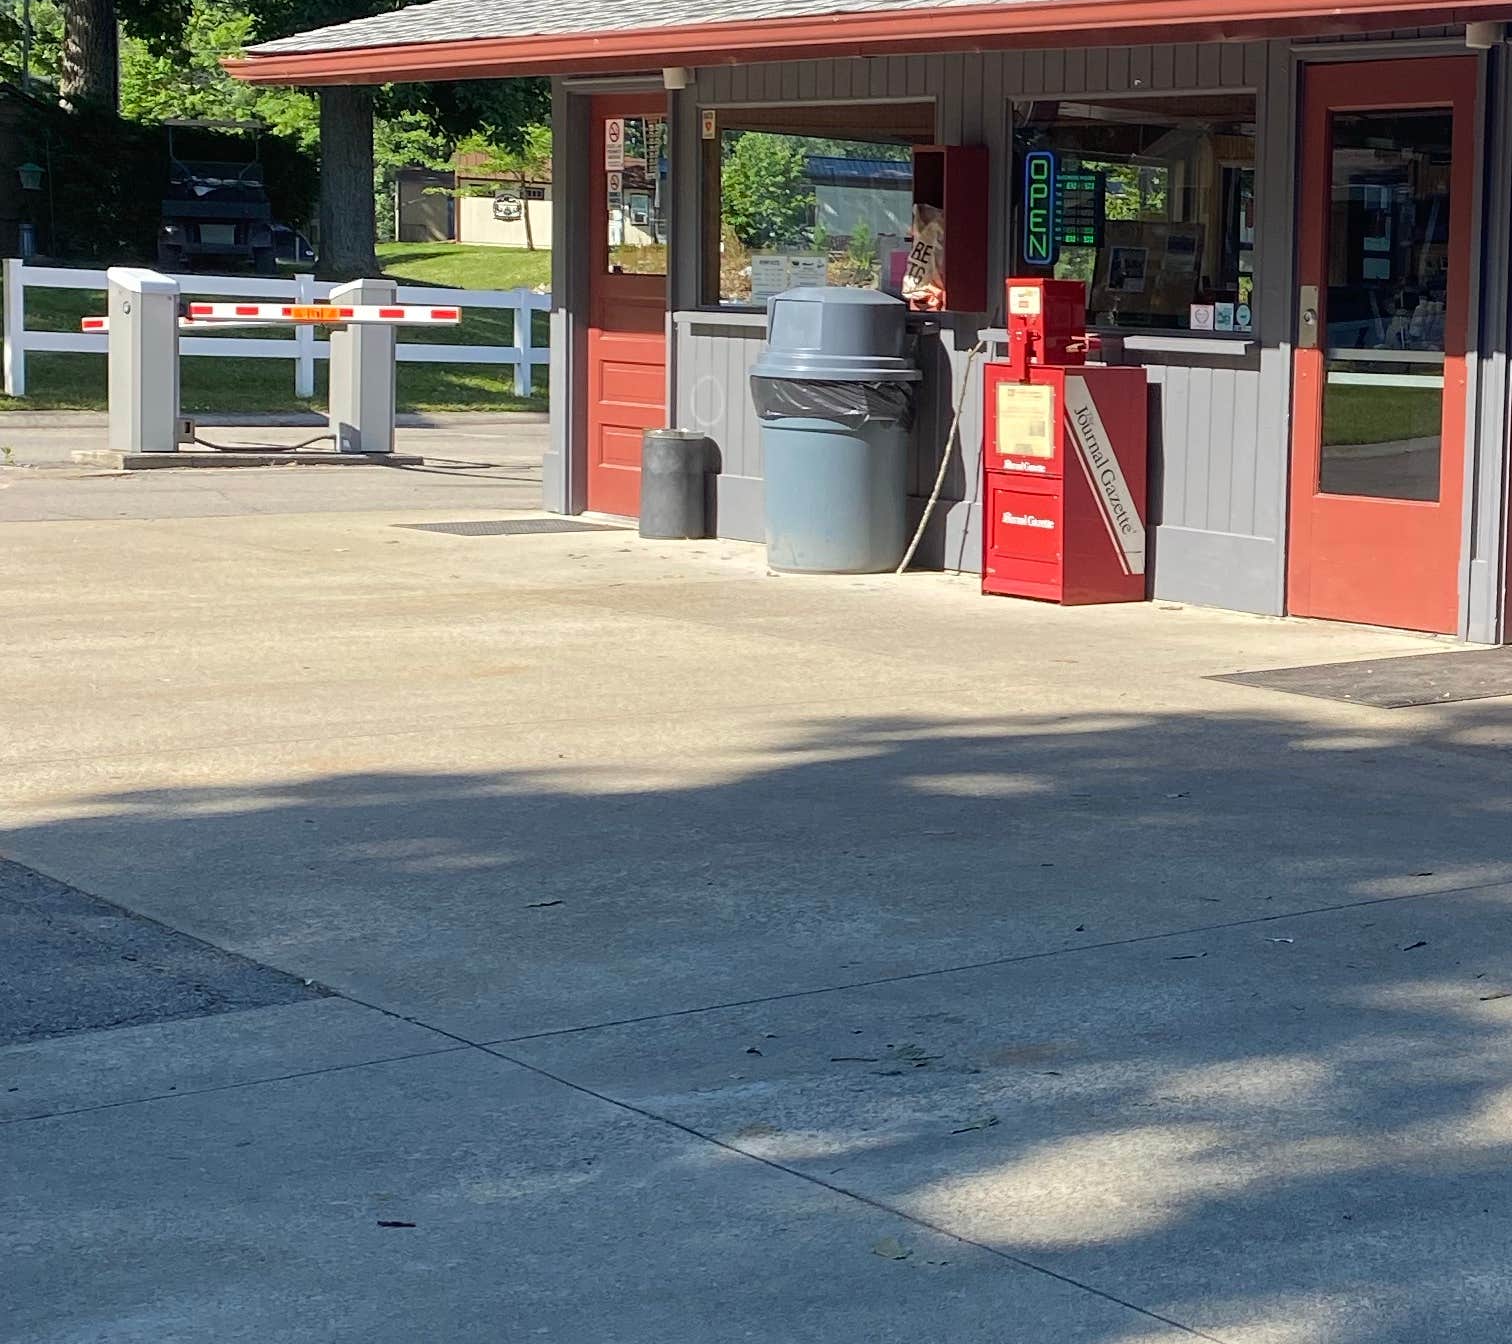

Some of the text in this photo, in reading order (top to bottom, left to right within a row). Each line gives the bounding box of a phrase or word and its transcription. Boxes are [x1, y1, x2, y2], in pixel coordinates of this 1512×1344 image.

[1029, 159, 1048, 258] OPEN
[1074, 406, 1133, 535] Journal Gazette
